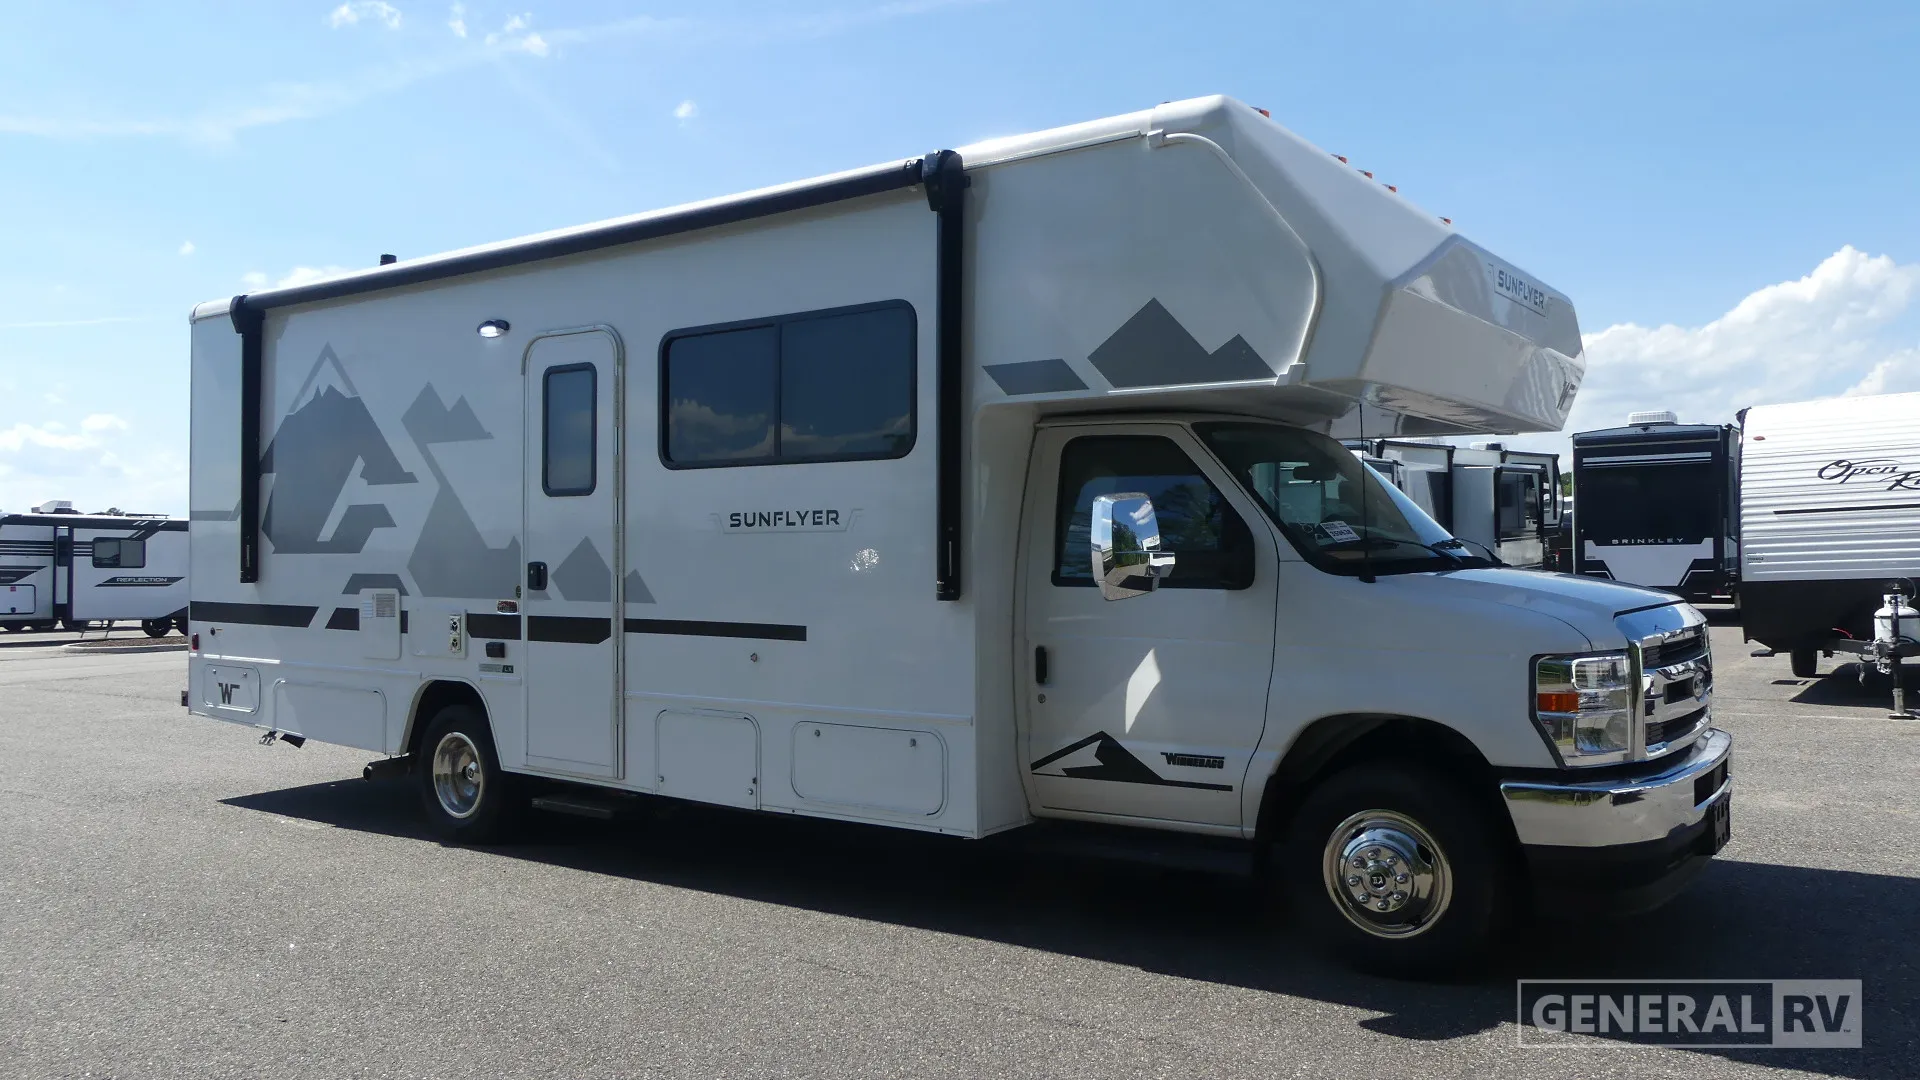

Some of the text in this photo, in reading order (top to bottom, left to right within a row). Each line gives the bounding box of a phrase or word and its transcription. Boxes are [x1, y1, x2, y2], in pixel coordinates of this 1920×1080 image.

[1498, 269, 1545, 309] SUNFLYER
[1817, 459, 1899, 484] Open
[729, 509, 840, 528] SUNFLYER
[1611, 537, 1684, 545] BRINKLEY
[1160, 751, 1225, 769] WINNEBAGO
